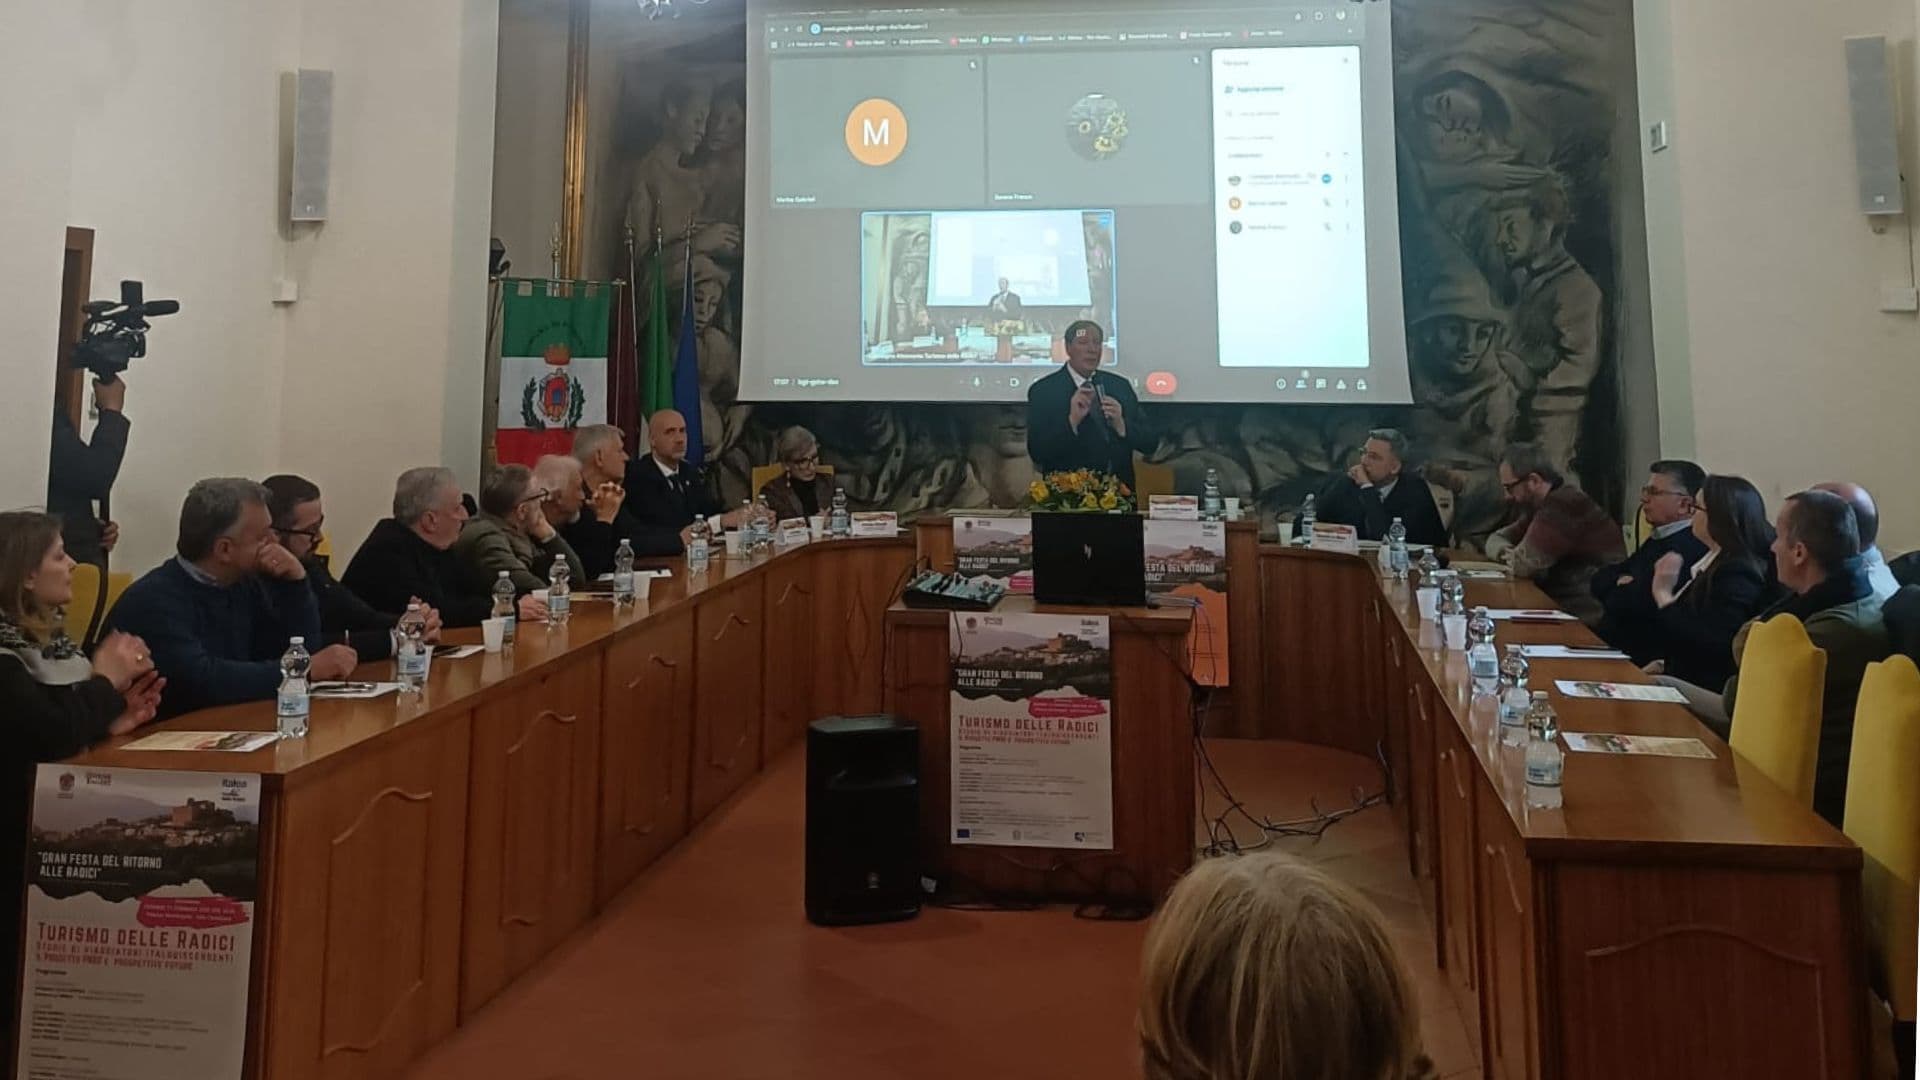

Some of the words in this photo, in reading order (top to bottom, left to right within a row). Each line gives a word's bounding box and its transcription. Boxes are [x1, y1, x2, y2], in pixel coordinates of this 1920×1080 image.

[863, 117, 889, 146] M
[1144, 563, 1166, 572] ESTA
[959, 715, 1010, 729] TURISMO
[1015, 718, 1051, 730] DELLE
[1058, 719, 1098, 733] RADICI
[69, 853, 100, 866] FESTA
[102, 855, 119, 867] DEL
[123, 856, 163, 869] RITORNO
[39, 865, 64, 877] ALLE
[38, 922, 109, 944] TURISMO
[118, 929, 169, 947] DELLE
[177, 930, 235, 952] RADICI
